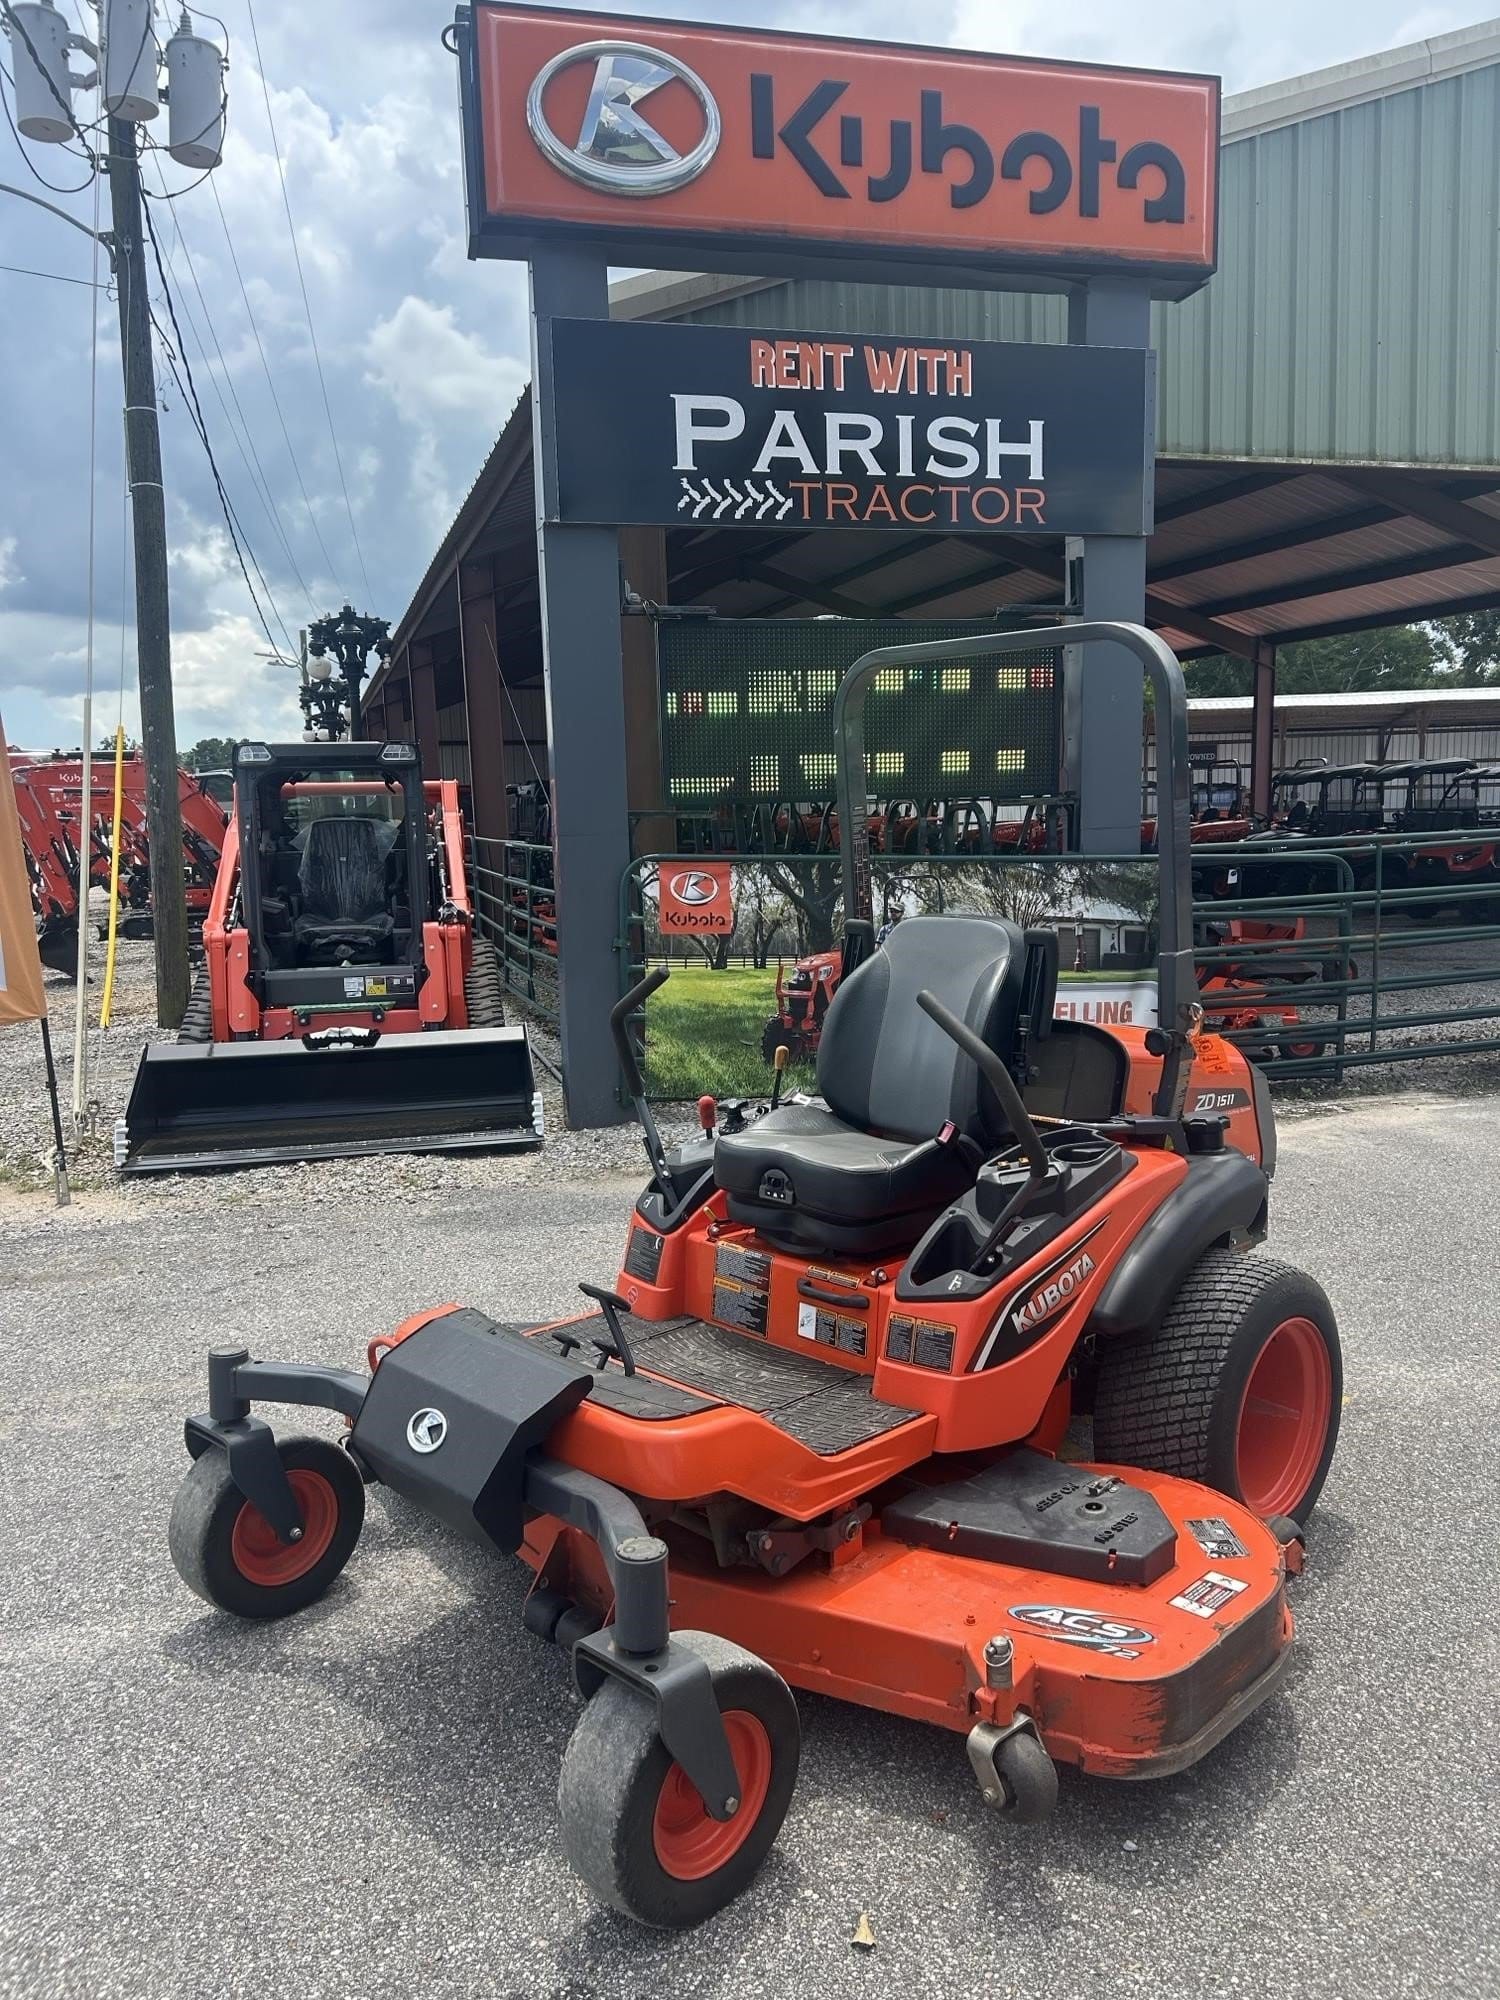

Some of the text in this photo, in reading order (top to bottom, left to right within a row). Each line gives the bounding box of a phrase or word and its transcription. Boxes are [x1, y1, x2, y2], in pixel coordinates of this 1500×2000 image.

[750, 73, 1186, 224] Kubota
[750, 340, 972, 396] RENT WITH
[670, 394, 1045, 481] PARISH
[789, 481, 1047, 525] TRACTOR
[60, 773, 98, 783] Kuba
[665, 912, 726, 927] Kubota
[1011, 1253, 1096, 1335] KUBOTA
[1026, 1607, 1136, 1639] ACS
[1097, 1643, 1141, 1661] 72
